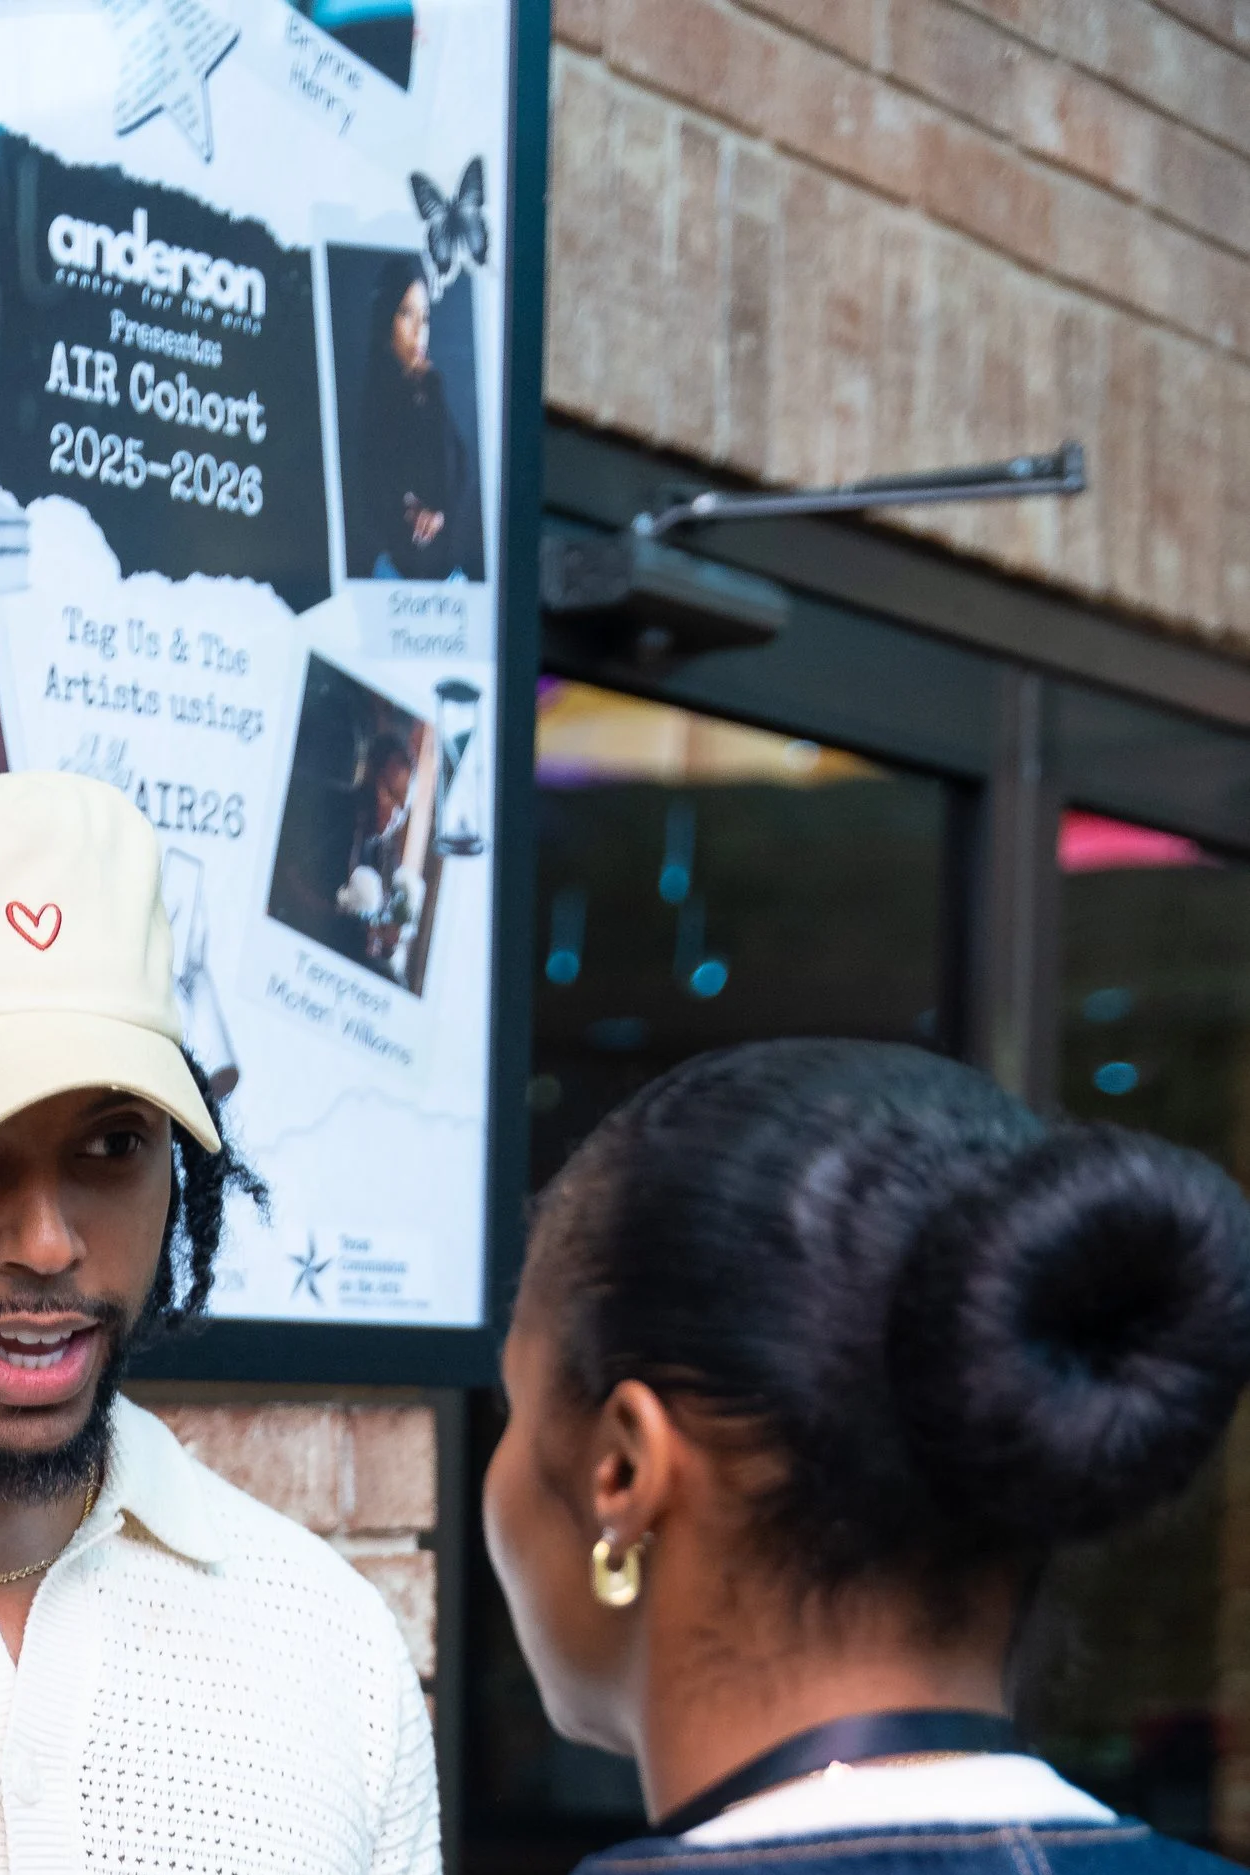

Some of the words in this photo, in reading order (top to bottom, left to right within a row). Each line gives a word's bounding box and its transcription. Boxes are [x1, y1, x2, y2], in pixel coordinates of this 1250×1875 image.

[48, 207, 266, 318] anderson
[45, 339, 121, 408] AIR
[129, 360, 267, 444] Cohort
[49, 422, 264, 517] 2025-2026
[44, 662, 161, 715] Artists
[62, 605, 117, 660] Tag
[127, 617, 161, 659] Us
[169, 626, 190, 663] &
[198, 631, 250, 677] The
